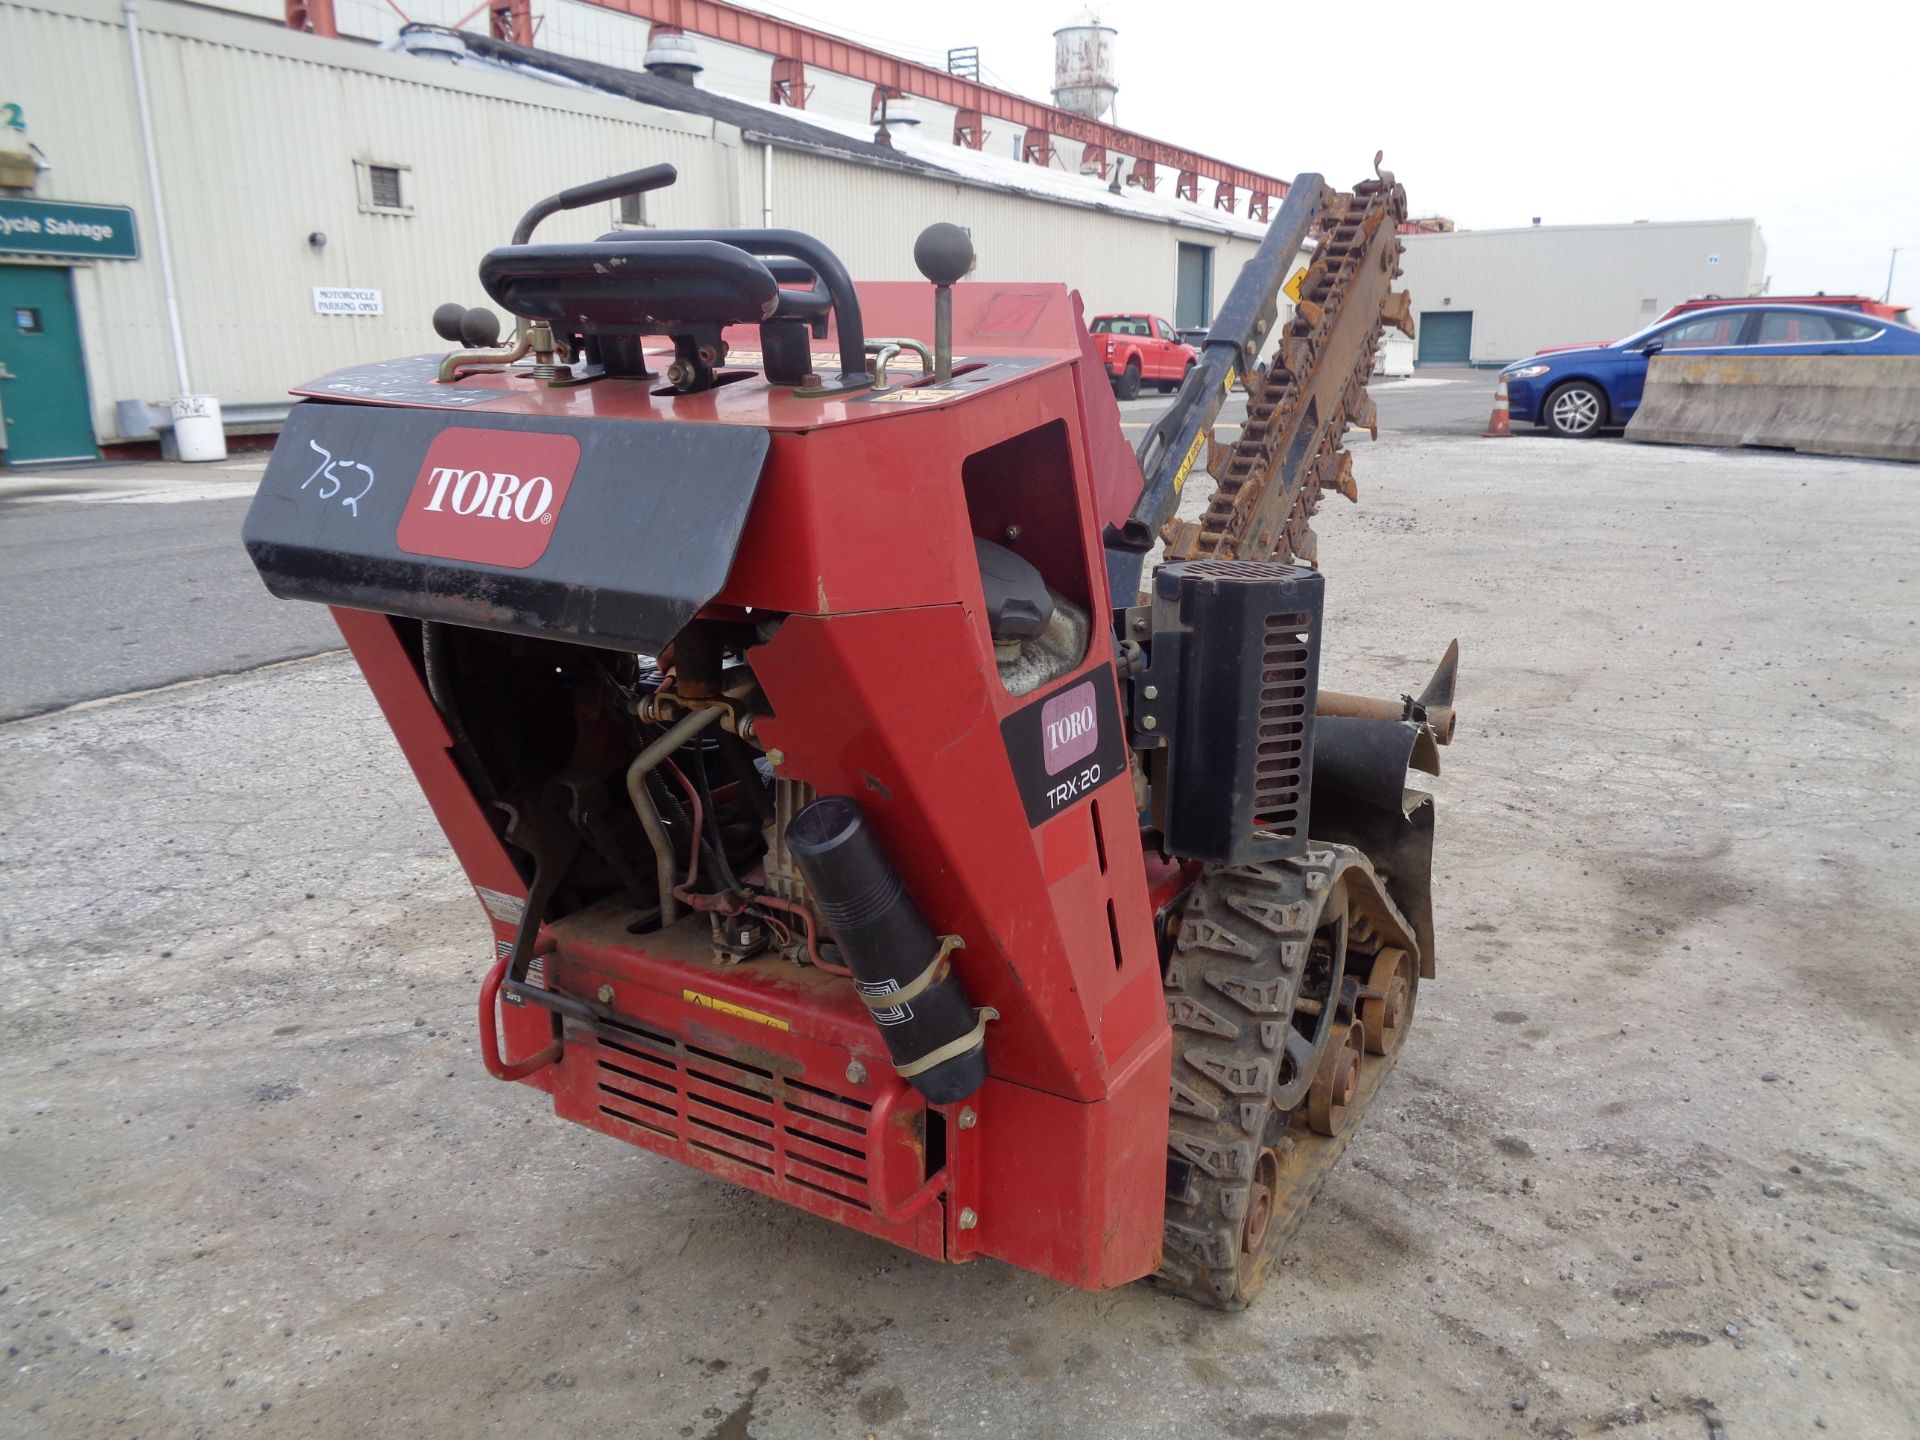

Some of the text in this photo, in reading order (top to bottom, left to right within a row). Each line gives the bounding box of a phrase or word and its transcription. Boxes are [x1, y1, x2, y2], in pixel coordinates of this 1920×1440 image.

[2, 102, 26, 129] 2
[44, 217, 113, 241] Salvage
[318, 301, 379, 312] PARKING ONLY
[319, 290, 376, 300] MOTORCYCLE
[300, 439, 374, 518] 752
[423, 466, 553, 524] TORO
[1047, 705, 1095, 751] TORO
